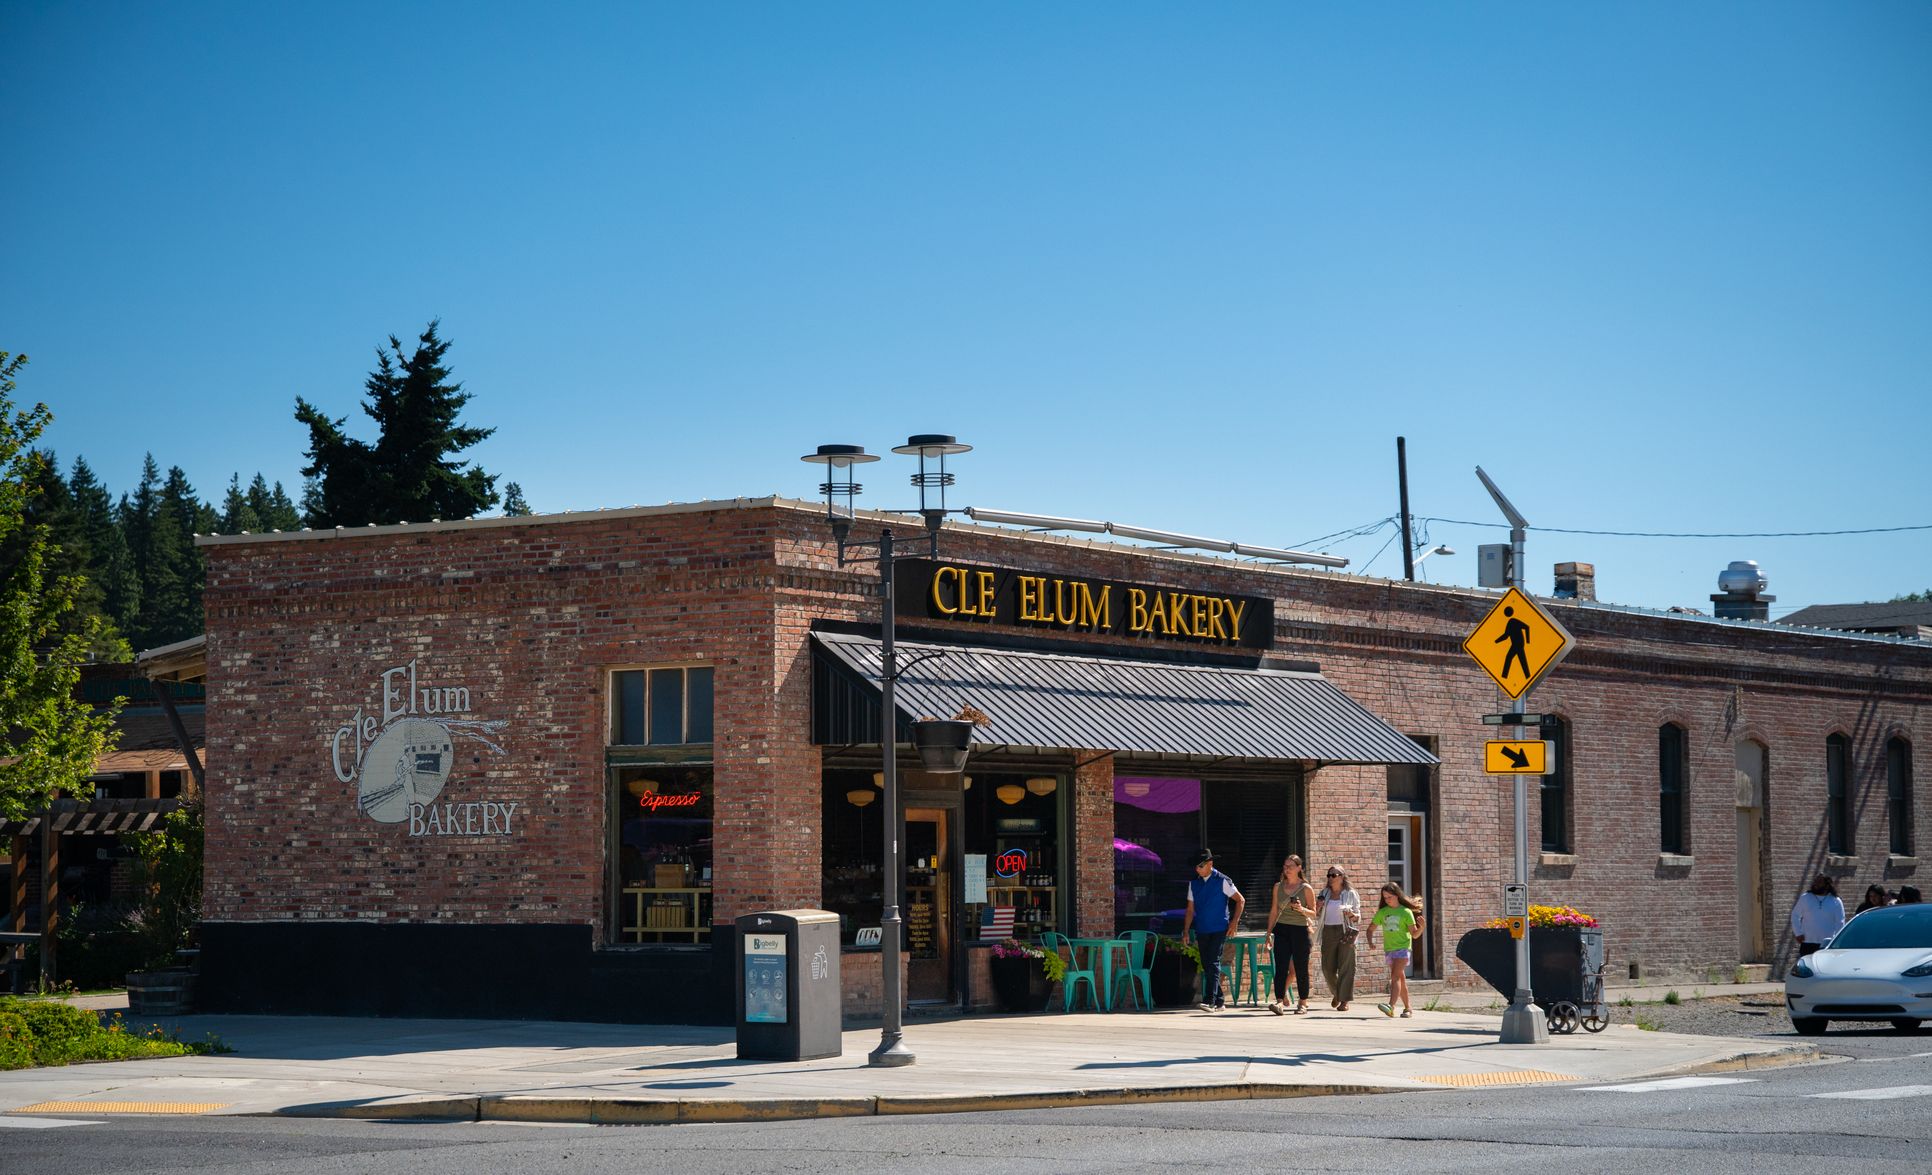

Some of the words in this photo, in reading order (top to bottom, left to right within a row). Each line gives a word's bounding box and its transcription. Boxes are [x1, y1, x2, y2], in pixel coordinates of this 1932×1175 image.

[932, 566, 997, 617] CLE
[1017, 575, 1112, 629] ELUM
[1127, 588, 1246, 641] BAKERY
[332, 706, 378, 783] Cle
[380, 658, 472, 727] Elum
[640, 790, 701, 811] Espresso
[409, 802, 518, 837] BAKERY
[996, 855, 1027, 872] OPEN
